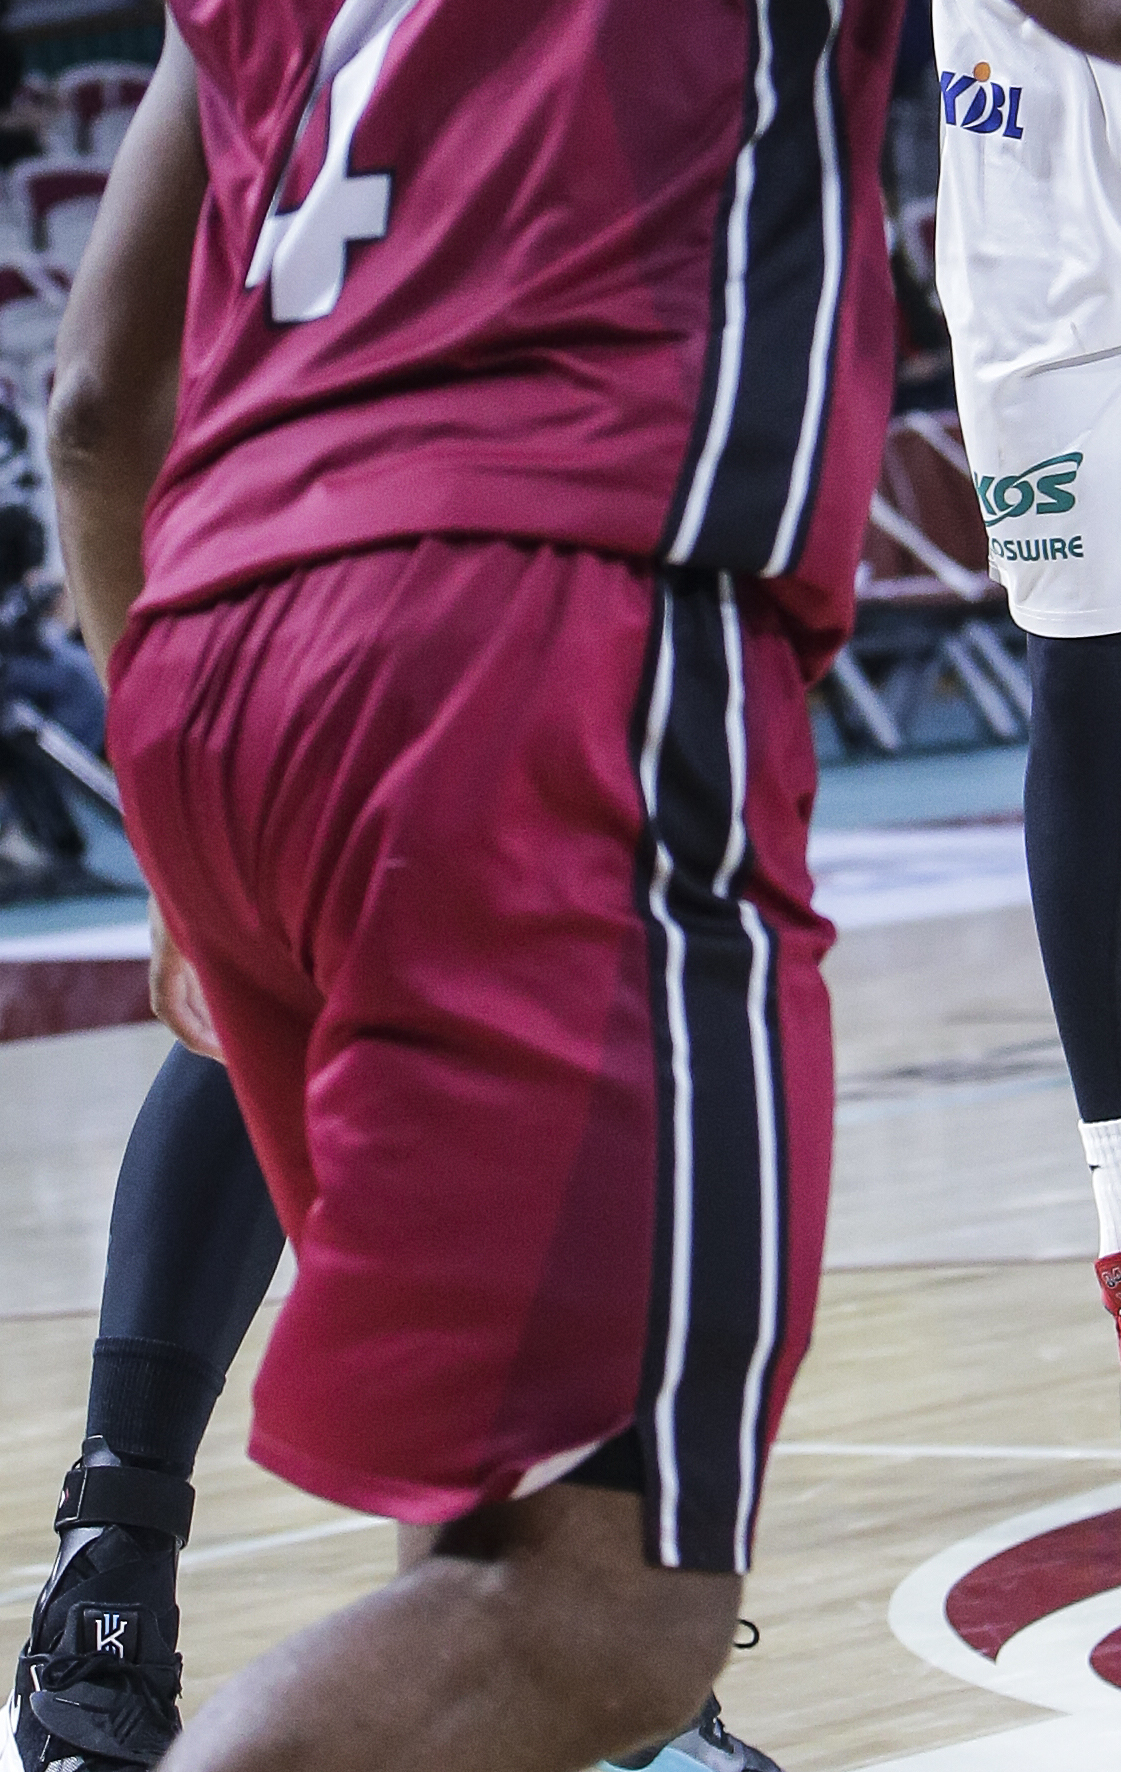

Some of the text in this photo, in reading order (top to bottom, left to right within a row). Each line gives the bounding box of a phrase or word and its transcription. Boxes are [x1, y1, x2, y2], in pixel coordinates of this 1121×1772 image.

[940, 71, 1024, 140] KBL
[974, 464, 1079, 520] KOS
[990, 534, 1084, 562] OSWIRE
